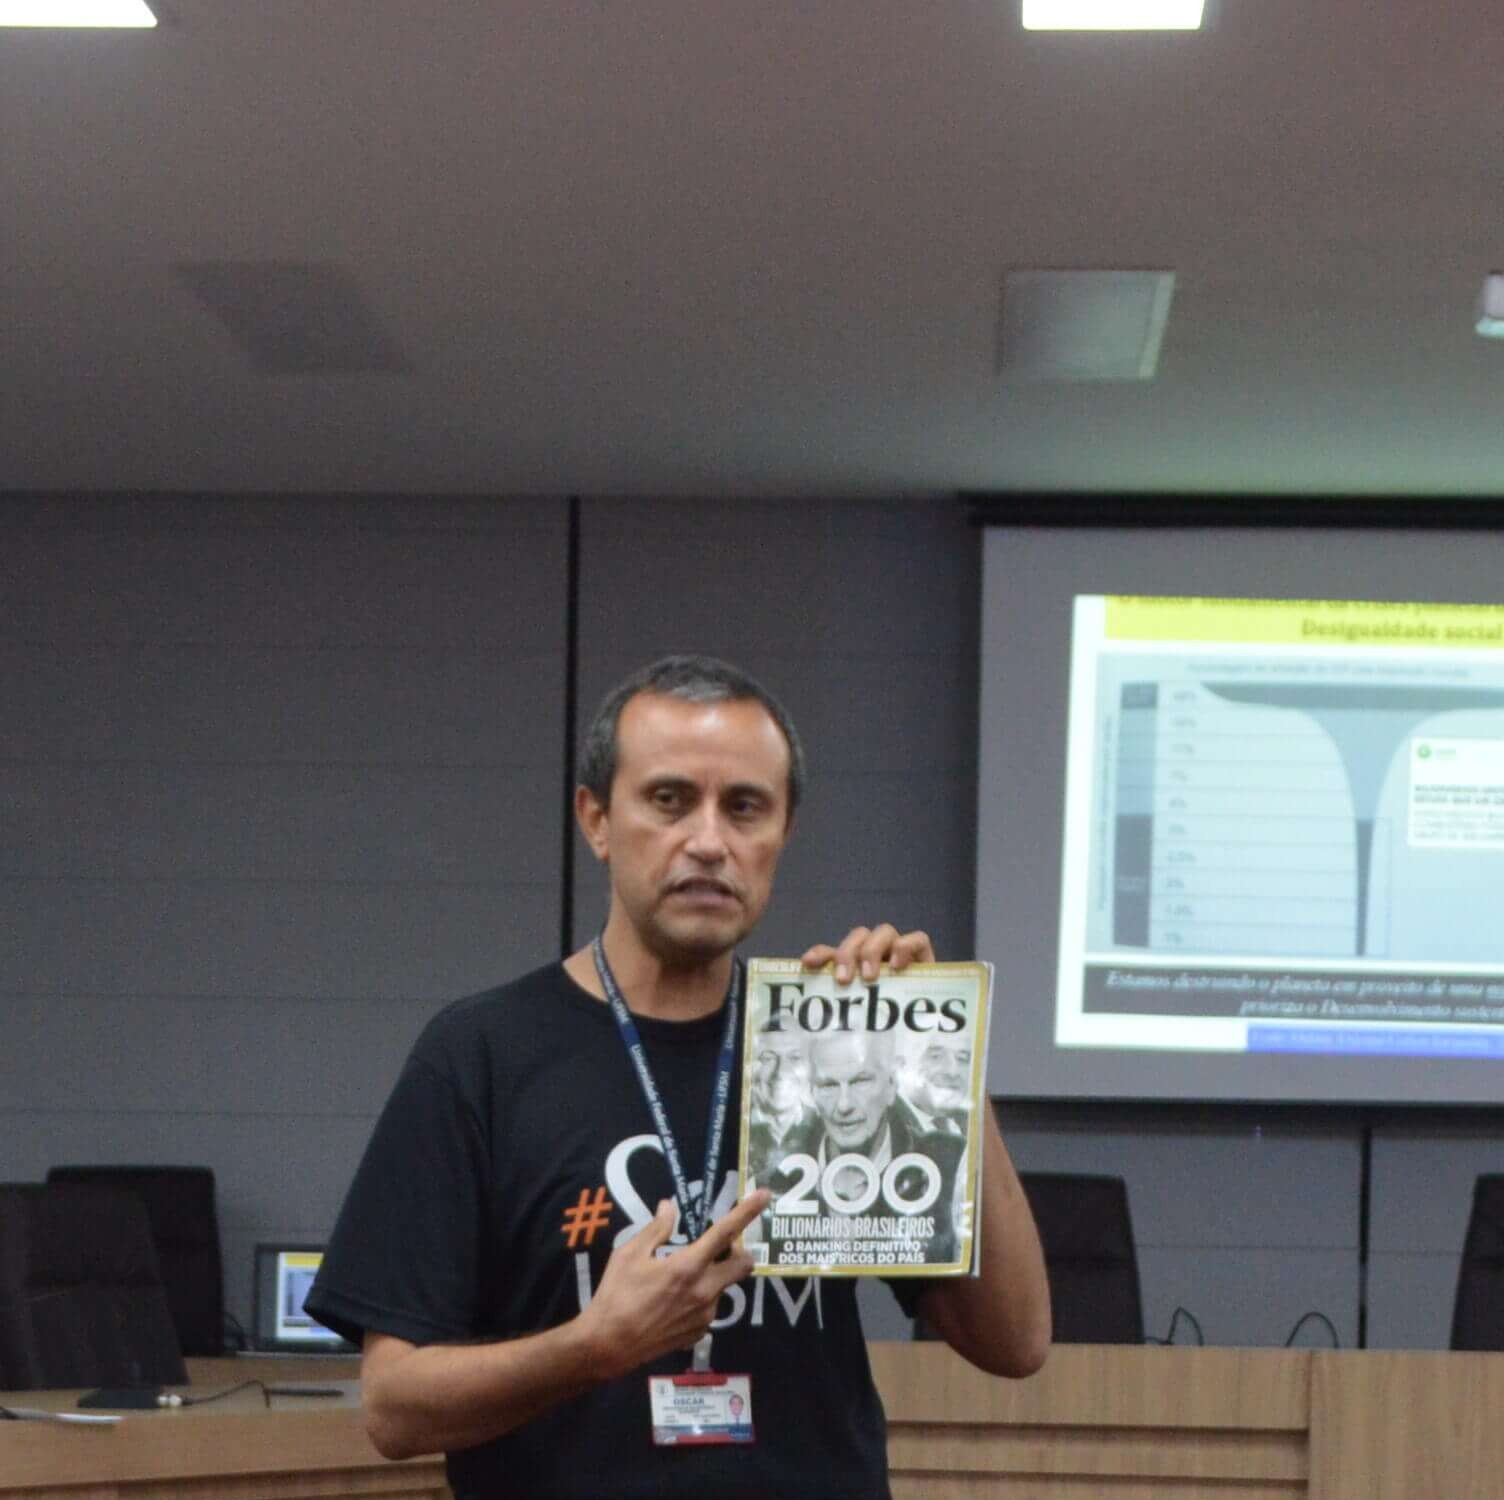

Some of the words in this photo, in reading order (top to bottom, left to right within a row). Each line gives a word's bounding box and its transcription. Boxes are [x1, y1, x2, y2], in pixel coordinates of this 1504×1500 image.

[1301, 618, 1440, 642] Desigualdade
[1444, 620, 1502, 640] social
[1271, 975, 1331, 994] planeta
[759, 982, 968, 1033] Forbes
[1320, 999, 1451, 1017] Desenvolvimento
[775, 1152, 942, 1215] 200
[772, 1214, 850, 1239] BILIONÁRIOS
[854, 1215, 935, 1239] BRASILEIROS
[783, 1241, 794, 1252] O
[796, 1241, 850, 1252] RANKING
[853, 1240, 921, 1252] DEFINITIVO
[778, 1252, 804, 1264] DOS
[806, 1252, 837, 1264] MAIS
[839, 1252, 874, 1264] RICOS
[877, 1252, 895, 1264] DO
[898, 1250, 925, 1264] PAÍS
[673, 1397, 704, 1406] OSCAR
